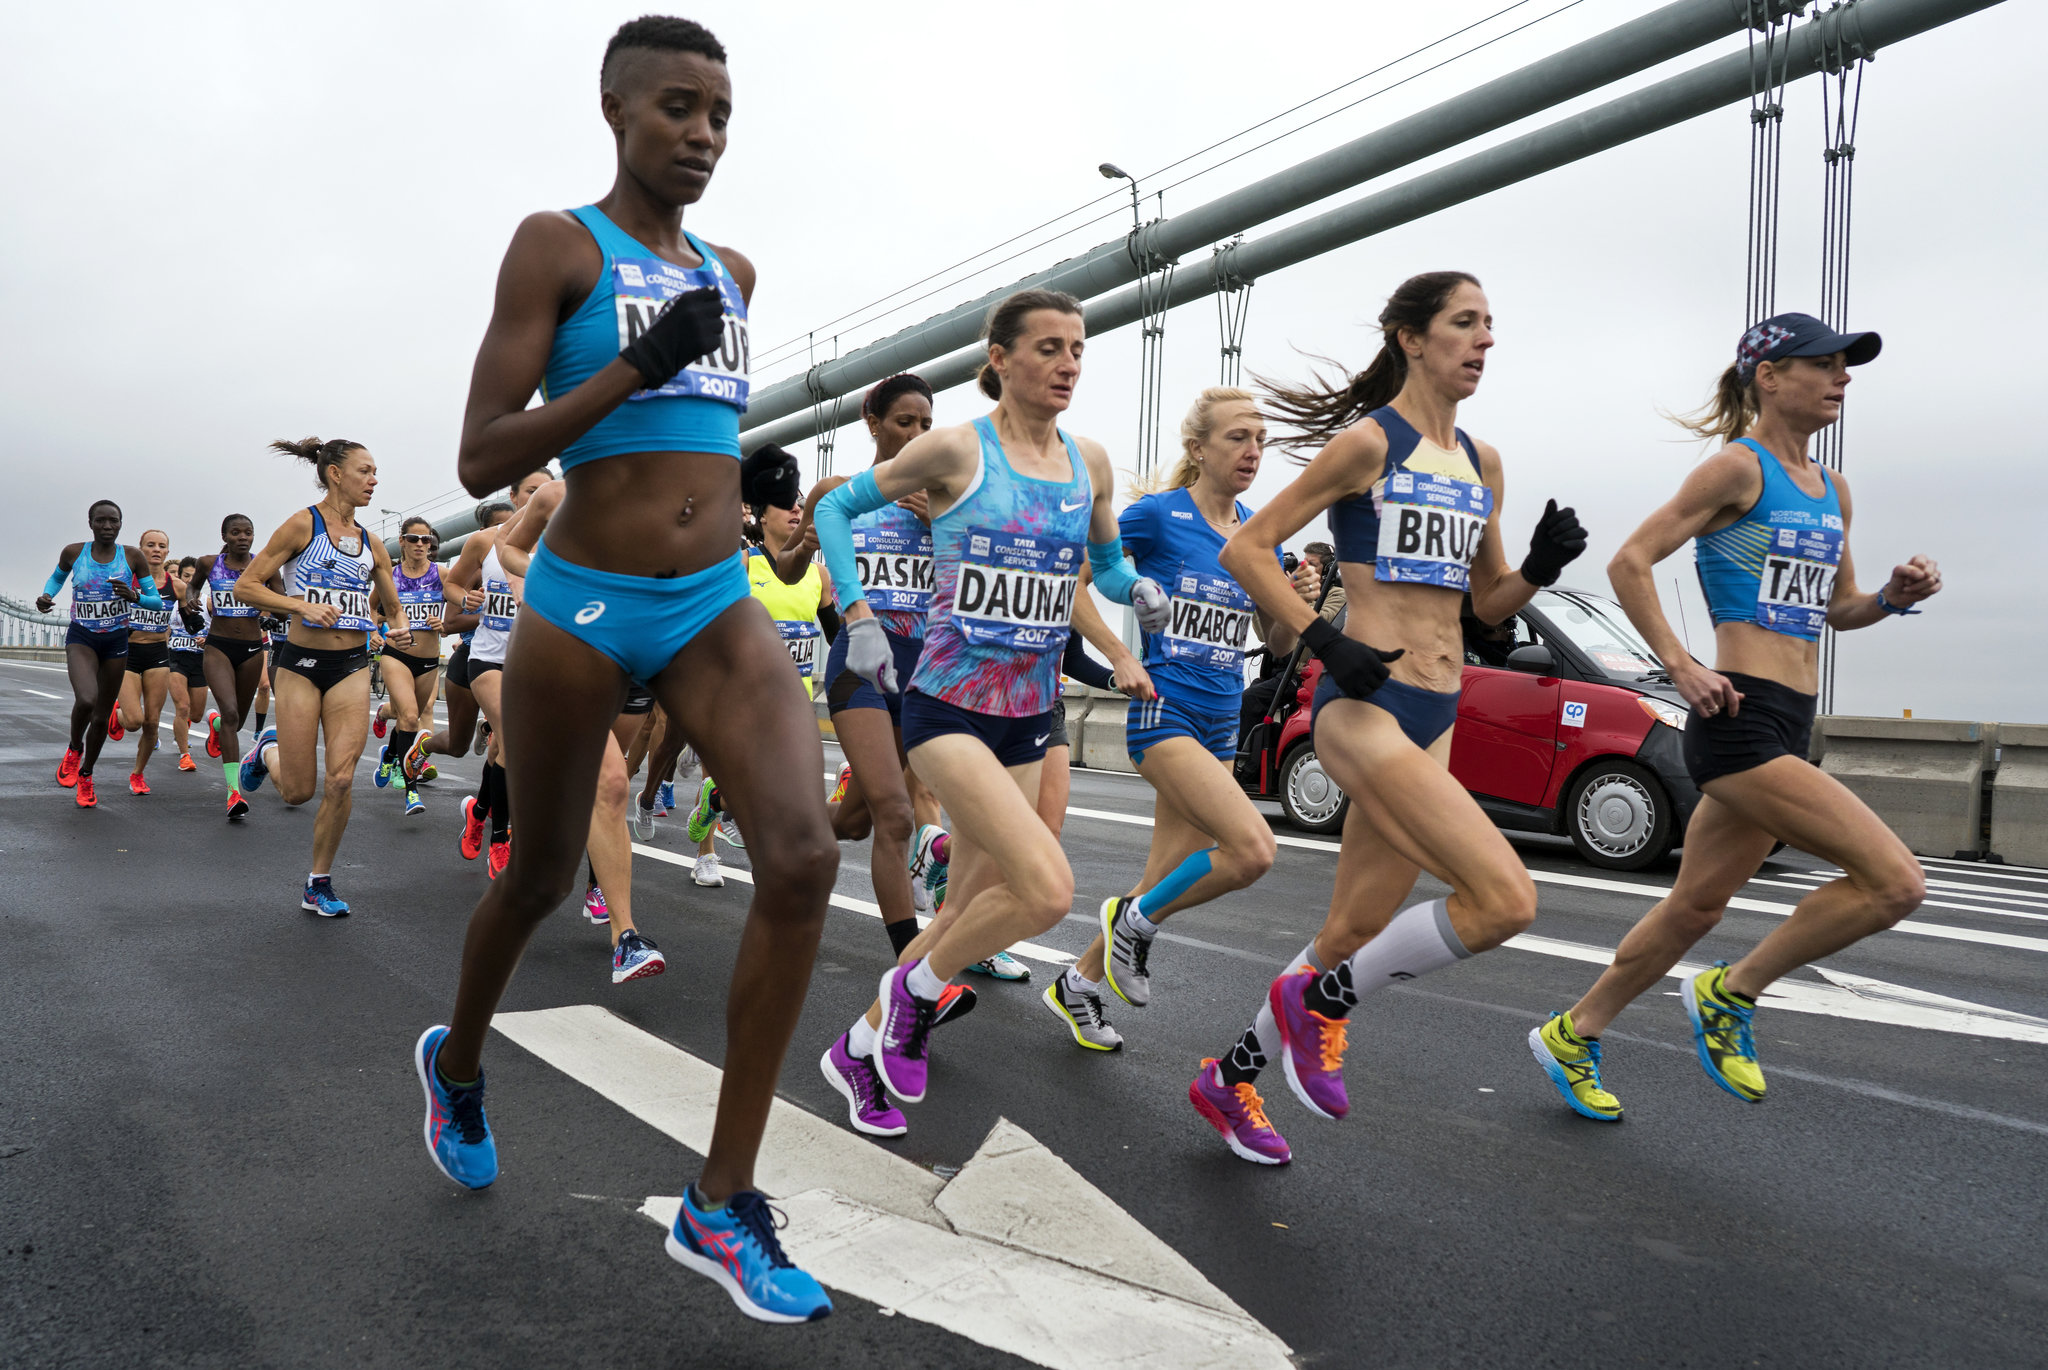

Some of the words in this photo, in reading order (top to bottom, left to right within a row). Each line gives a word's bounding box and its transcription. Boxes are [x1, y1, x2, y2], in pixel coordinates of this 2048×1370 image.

[699, 376, 737, 399] 2017
[868, 537, 911, 545] CONSULTANCY
[1013, 538, 1036, 548] TATA
[1397, 509, 1486, 564] BRUC
[875, 544, 903, 552] SERVICES
[972, 543, 988, 551] RUN
[995, 545, 1048, 559] CONSULTANCY
[1212, 579, 1229, 589] TATA
[892, 592, 918, 604] 2017
[958, 568, 1077, 622] DAUNAY
[77, 600, 129, 619] KIPLAGAT
[402, 604, 440, 621] GUSTO
[130, 609, 171, 625] LANAGAN
[338, 618, 360, 626] 2017
[1014, 627, 1050, 643] 2017
[1211, 648, 1235, 663] 2017
